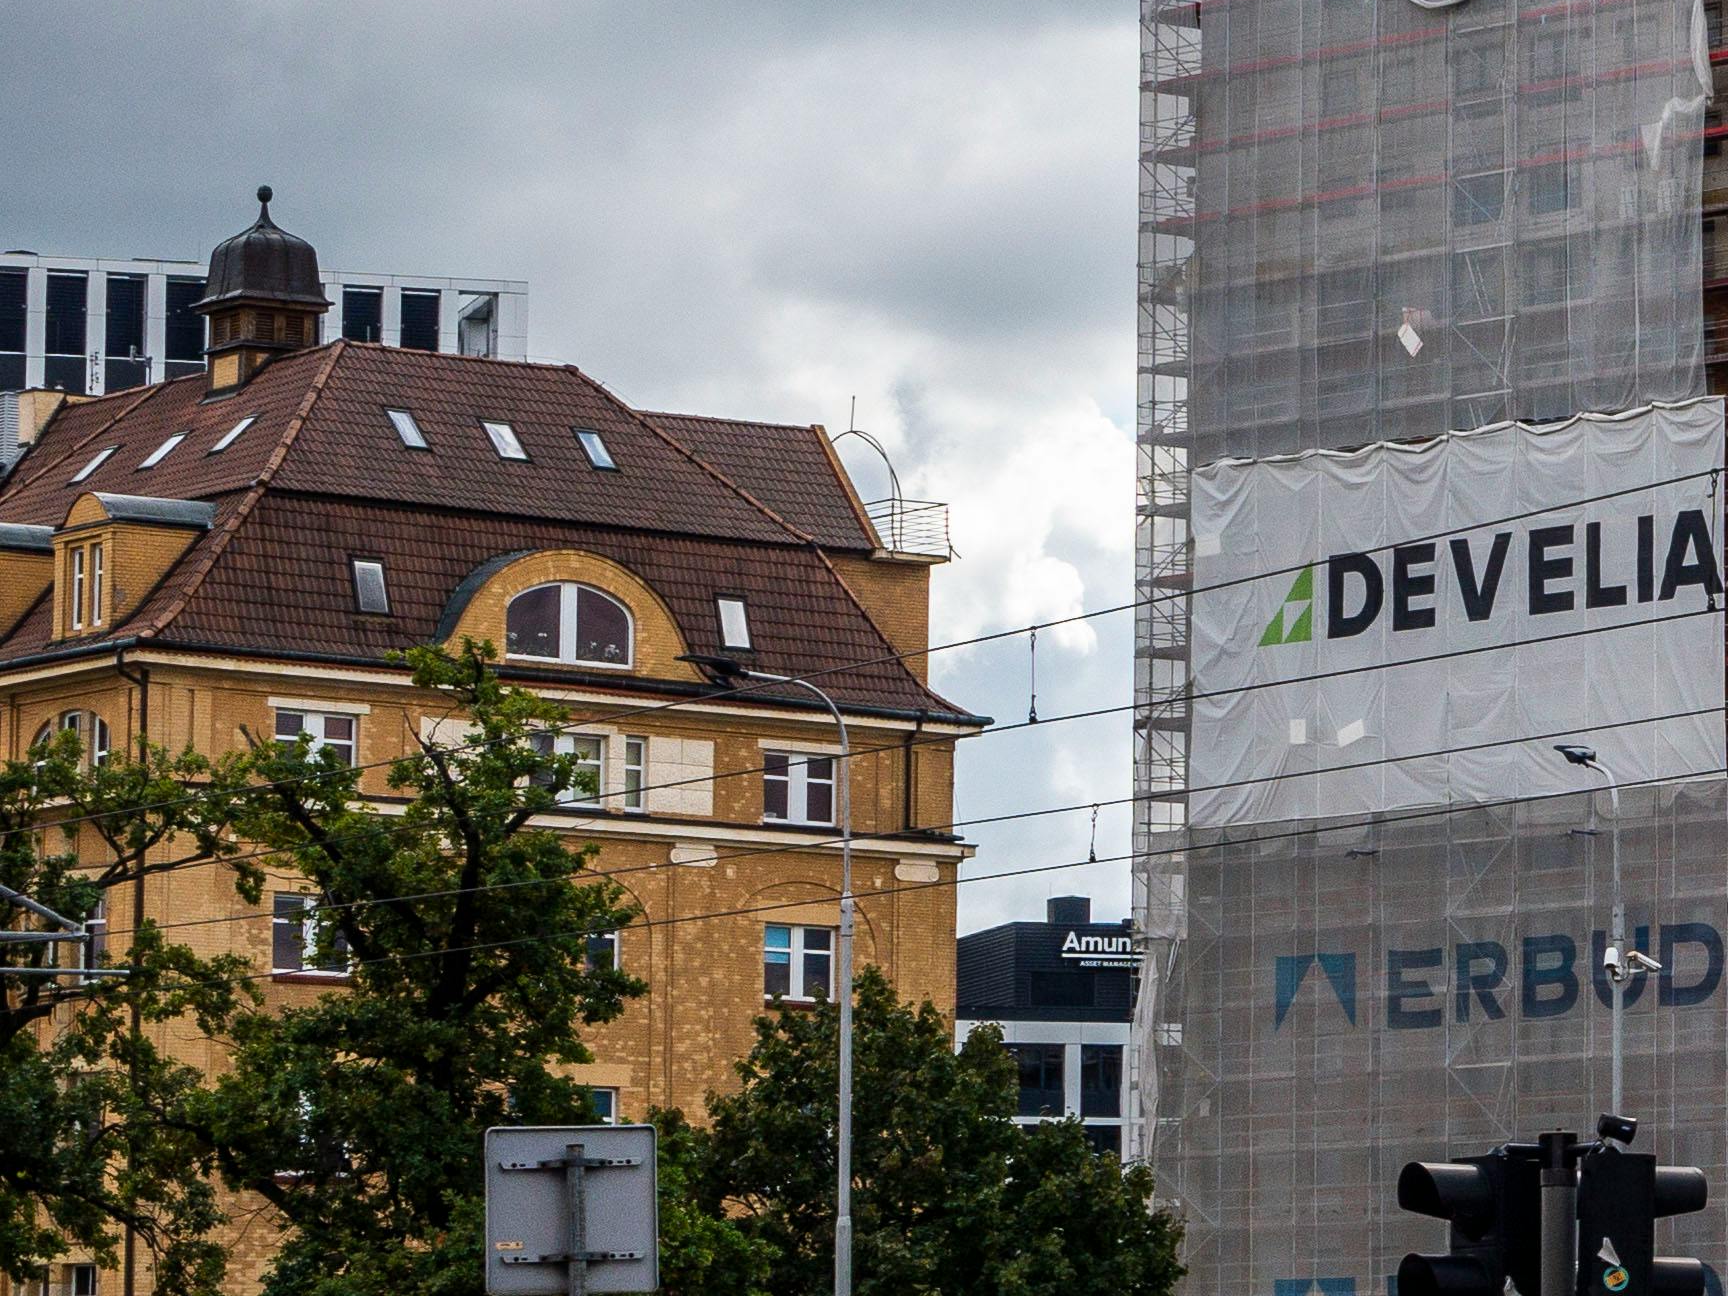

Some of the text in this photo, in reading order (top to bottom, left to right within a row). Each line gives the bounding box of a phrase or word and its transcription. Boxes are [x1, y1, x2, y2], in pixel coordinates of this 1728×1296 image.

[1327, 509, 1725, 639] DEVELIA
[1062, 931, 1137, 952] Amun
[1386, 922, 1725, 1030] ERBUD
